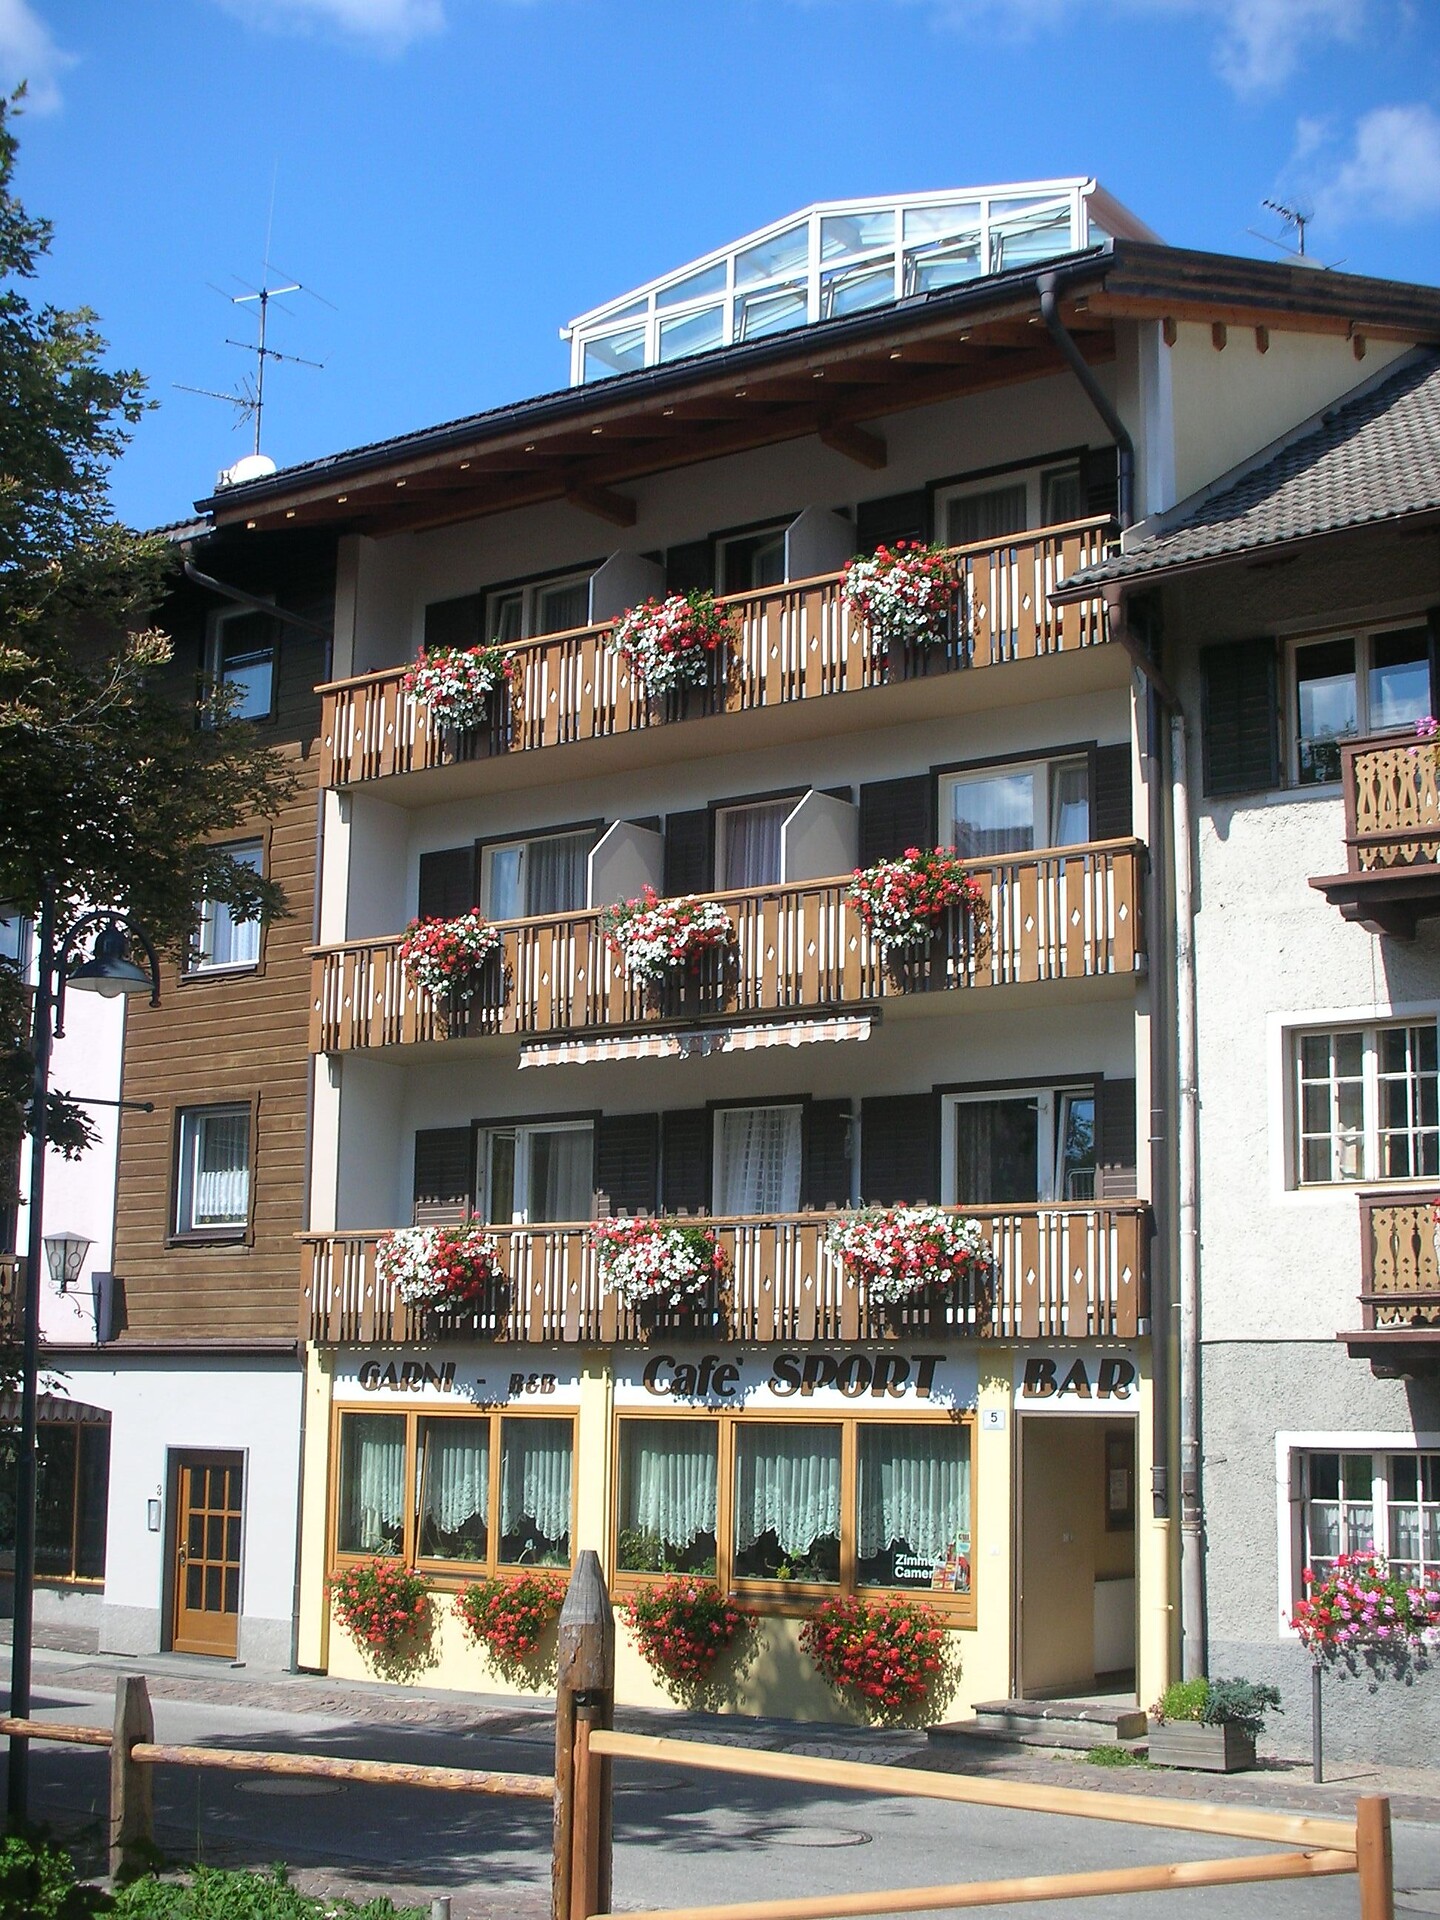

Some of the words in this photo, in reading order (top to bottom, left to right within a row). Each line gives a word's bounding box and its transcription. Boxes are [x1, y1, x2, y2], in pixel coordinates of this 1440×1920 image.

[358, 1360, 456, 1392] GARNI
[508, 1373, 557, 1394] B&B
[768, 1355, 947, 1398] SPORT
[1023, 1358, 1136, 1400] BAR
[991, 1412, 998, 1423] 5
[894, 1566, 935, 1579] Camer
